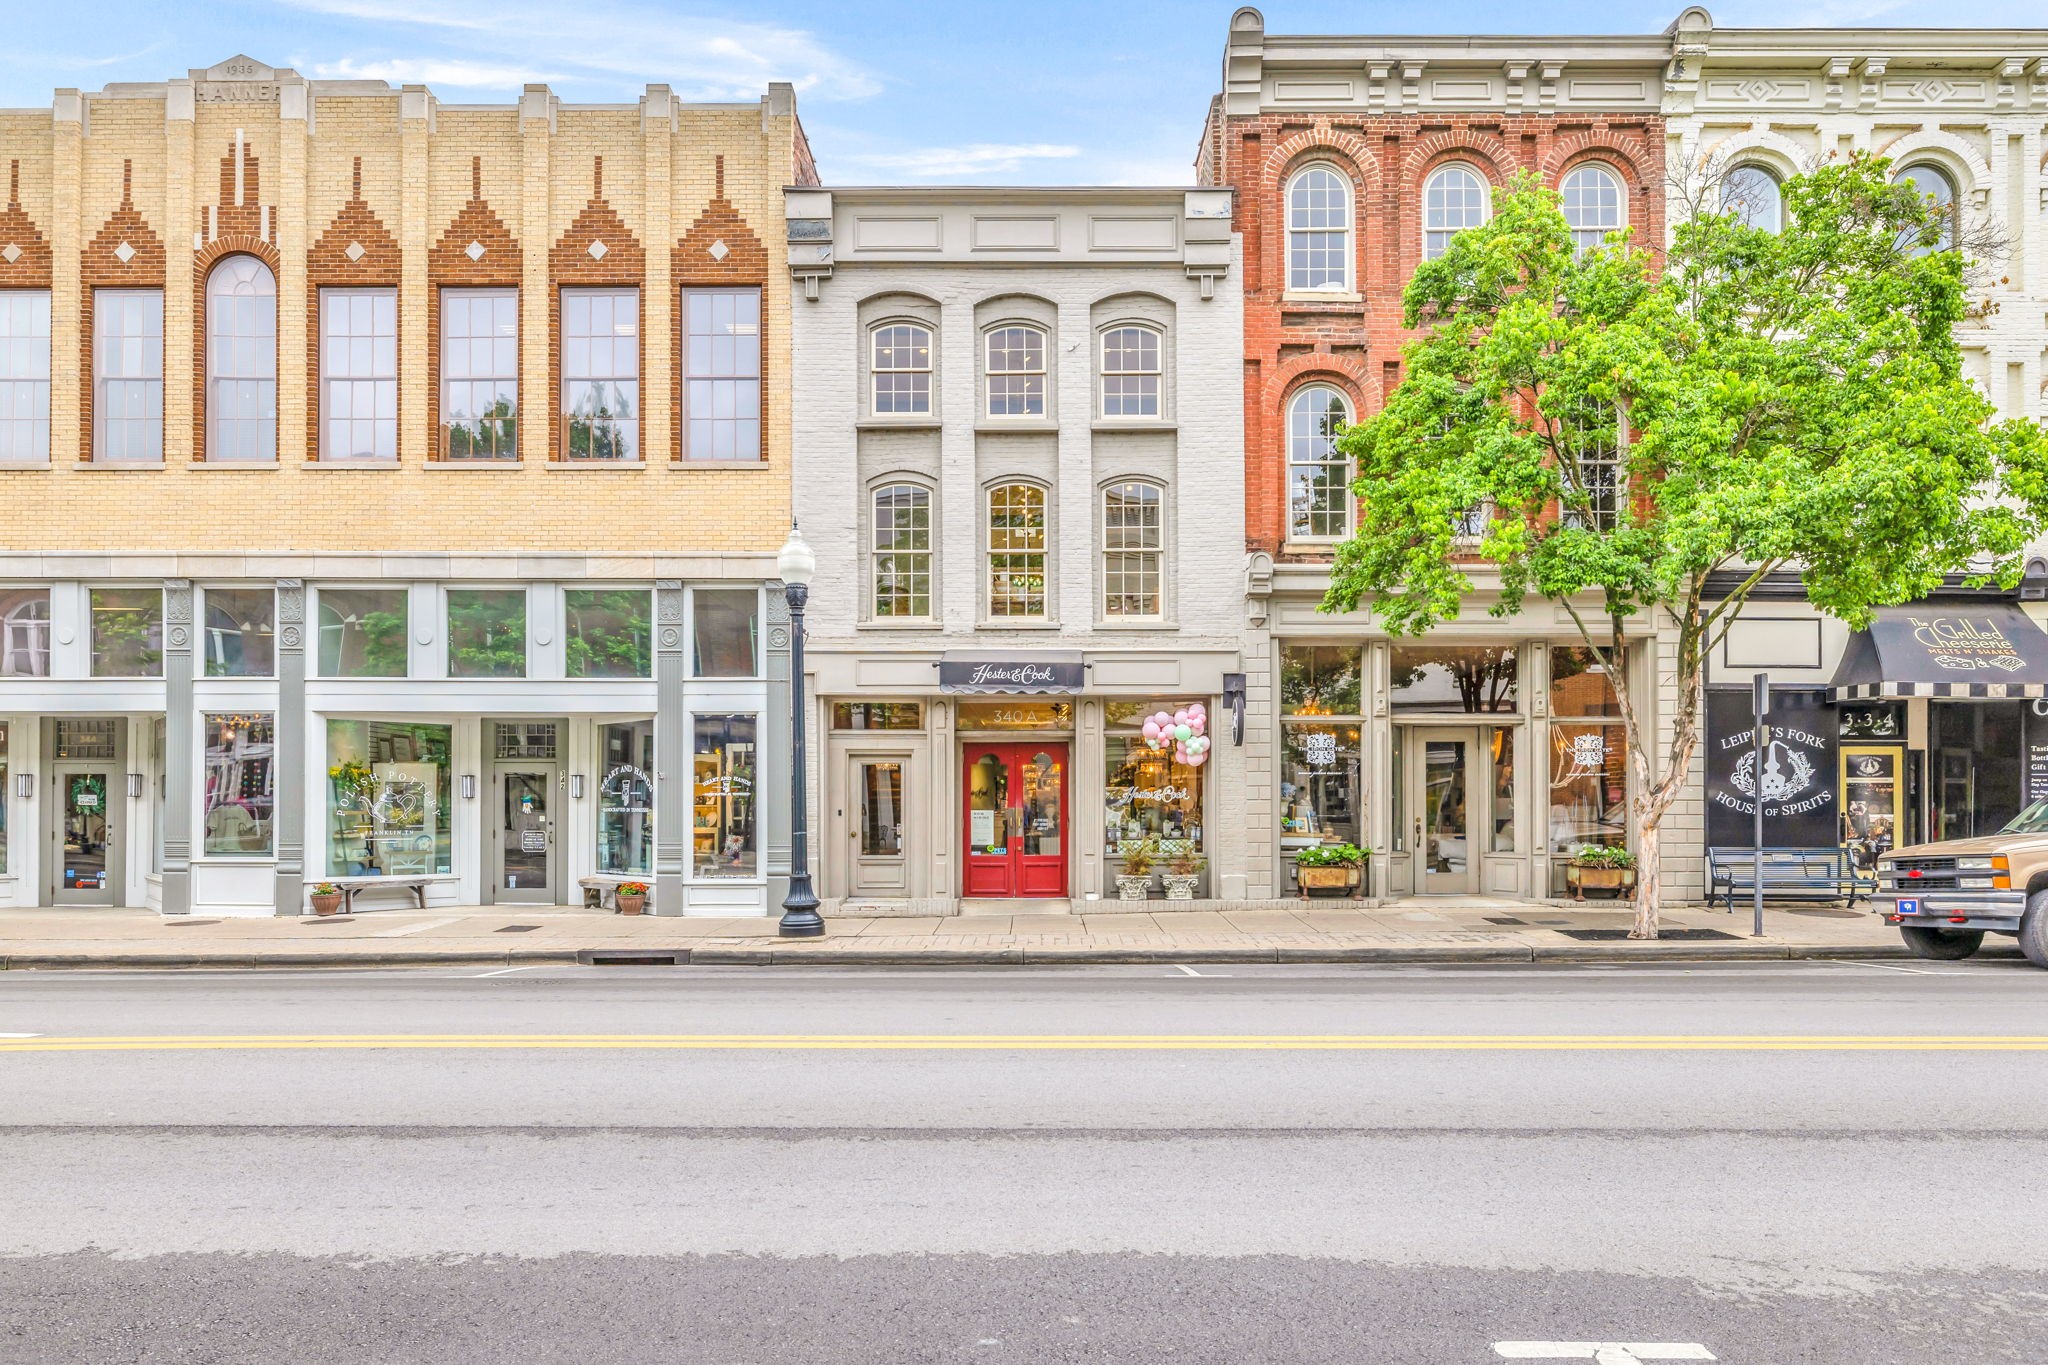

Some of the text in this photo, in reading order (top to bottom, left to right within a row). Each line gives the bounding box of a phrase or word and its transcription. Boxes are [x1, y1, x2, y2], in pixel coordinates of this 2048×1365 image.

[226, 65, 253, 76] 1935
[1907, 617, 1929, 627] The
[1932, 618, 2004, 640] Grilled
[1914, 626, 2013, 649] Cheeserie
[1977, 648, 2018, 656] SHAKES
[993, 710, 1038, 723] 340 A
[1720, 727, 1826, 750] LEIP'S FORK
[600, 764, 654, 793] HEART AND HANDS
[336, 771, 441, 817] POLISH POTTERY
[1715, 790, 1832, 817] HOUS OF SPIRITS
